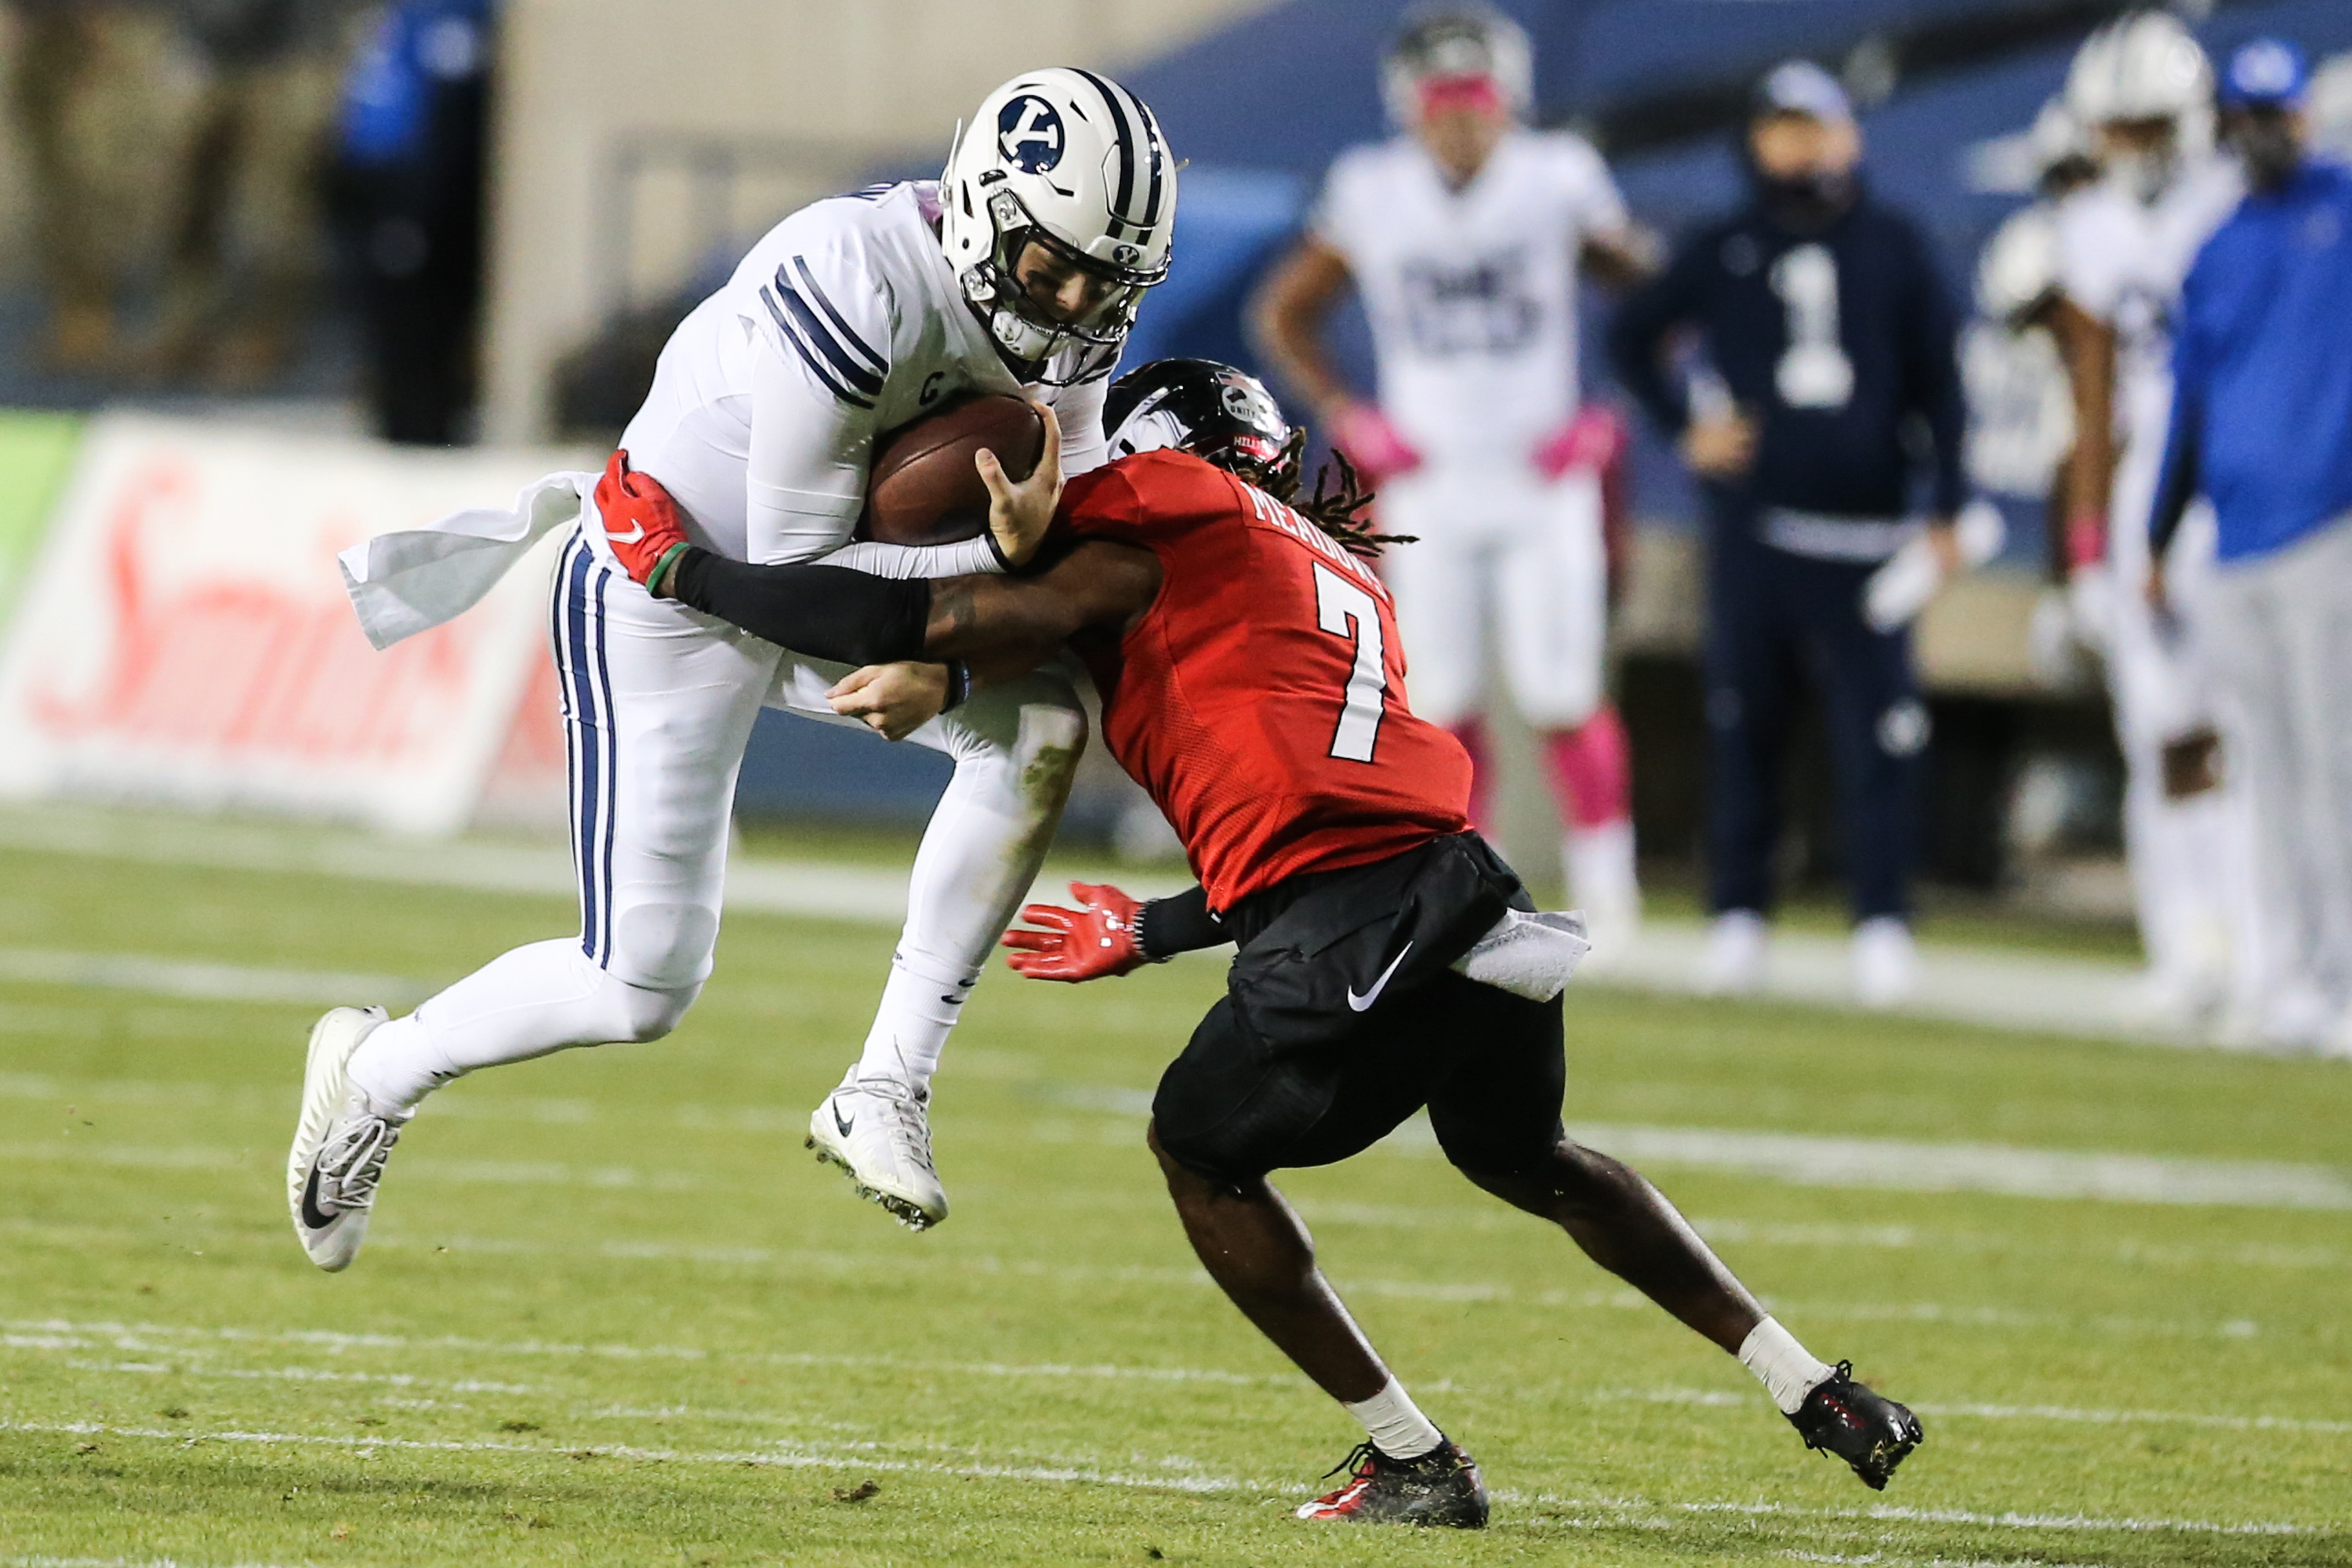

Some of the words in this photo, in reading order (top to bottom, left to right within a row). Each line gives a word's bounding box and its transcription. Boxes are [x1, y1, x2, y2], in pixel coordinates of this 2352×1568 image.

[1000, 97, 1058, 158] Y
[1767, 241, 1857, 409] 1
[1238, 481, 1389, 602] MEADOWS
[1312, 559, 1386, 764] 7
